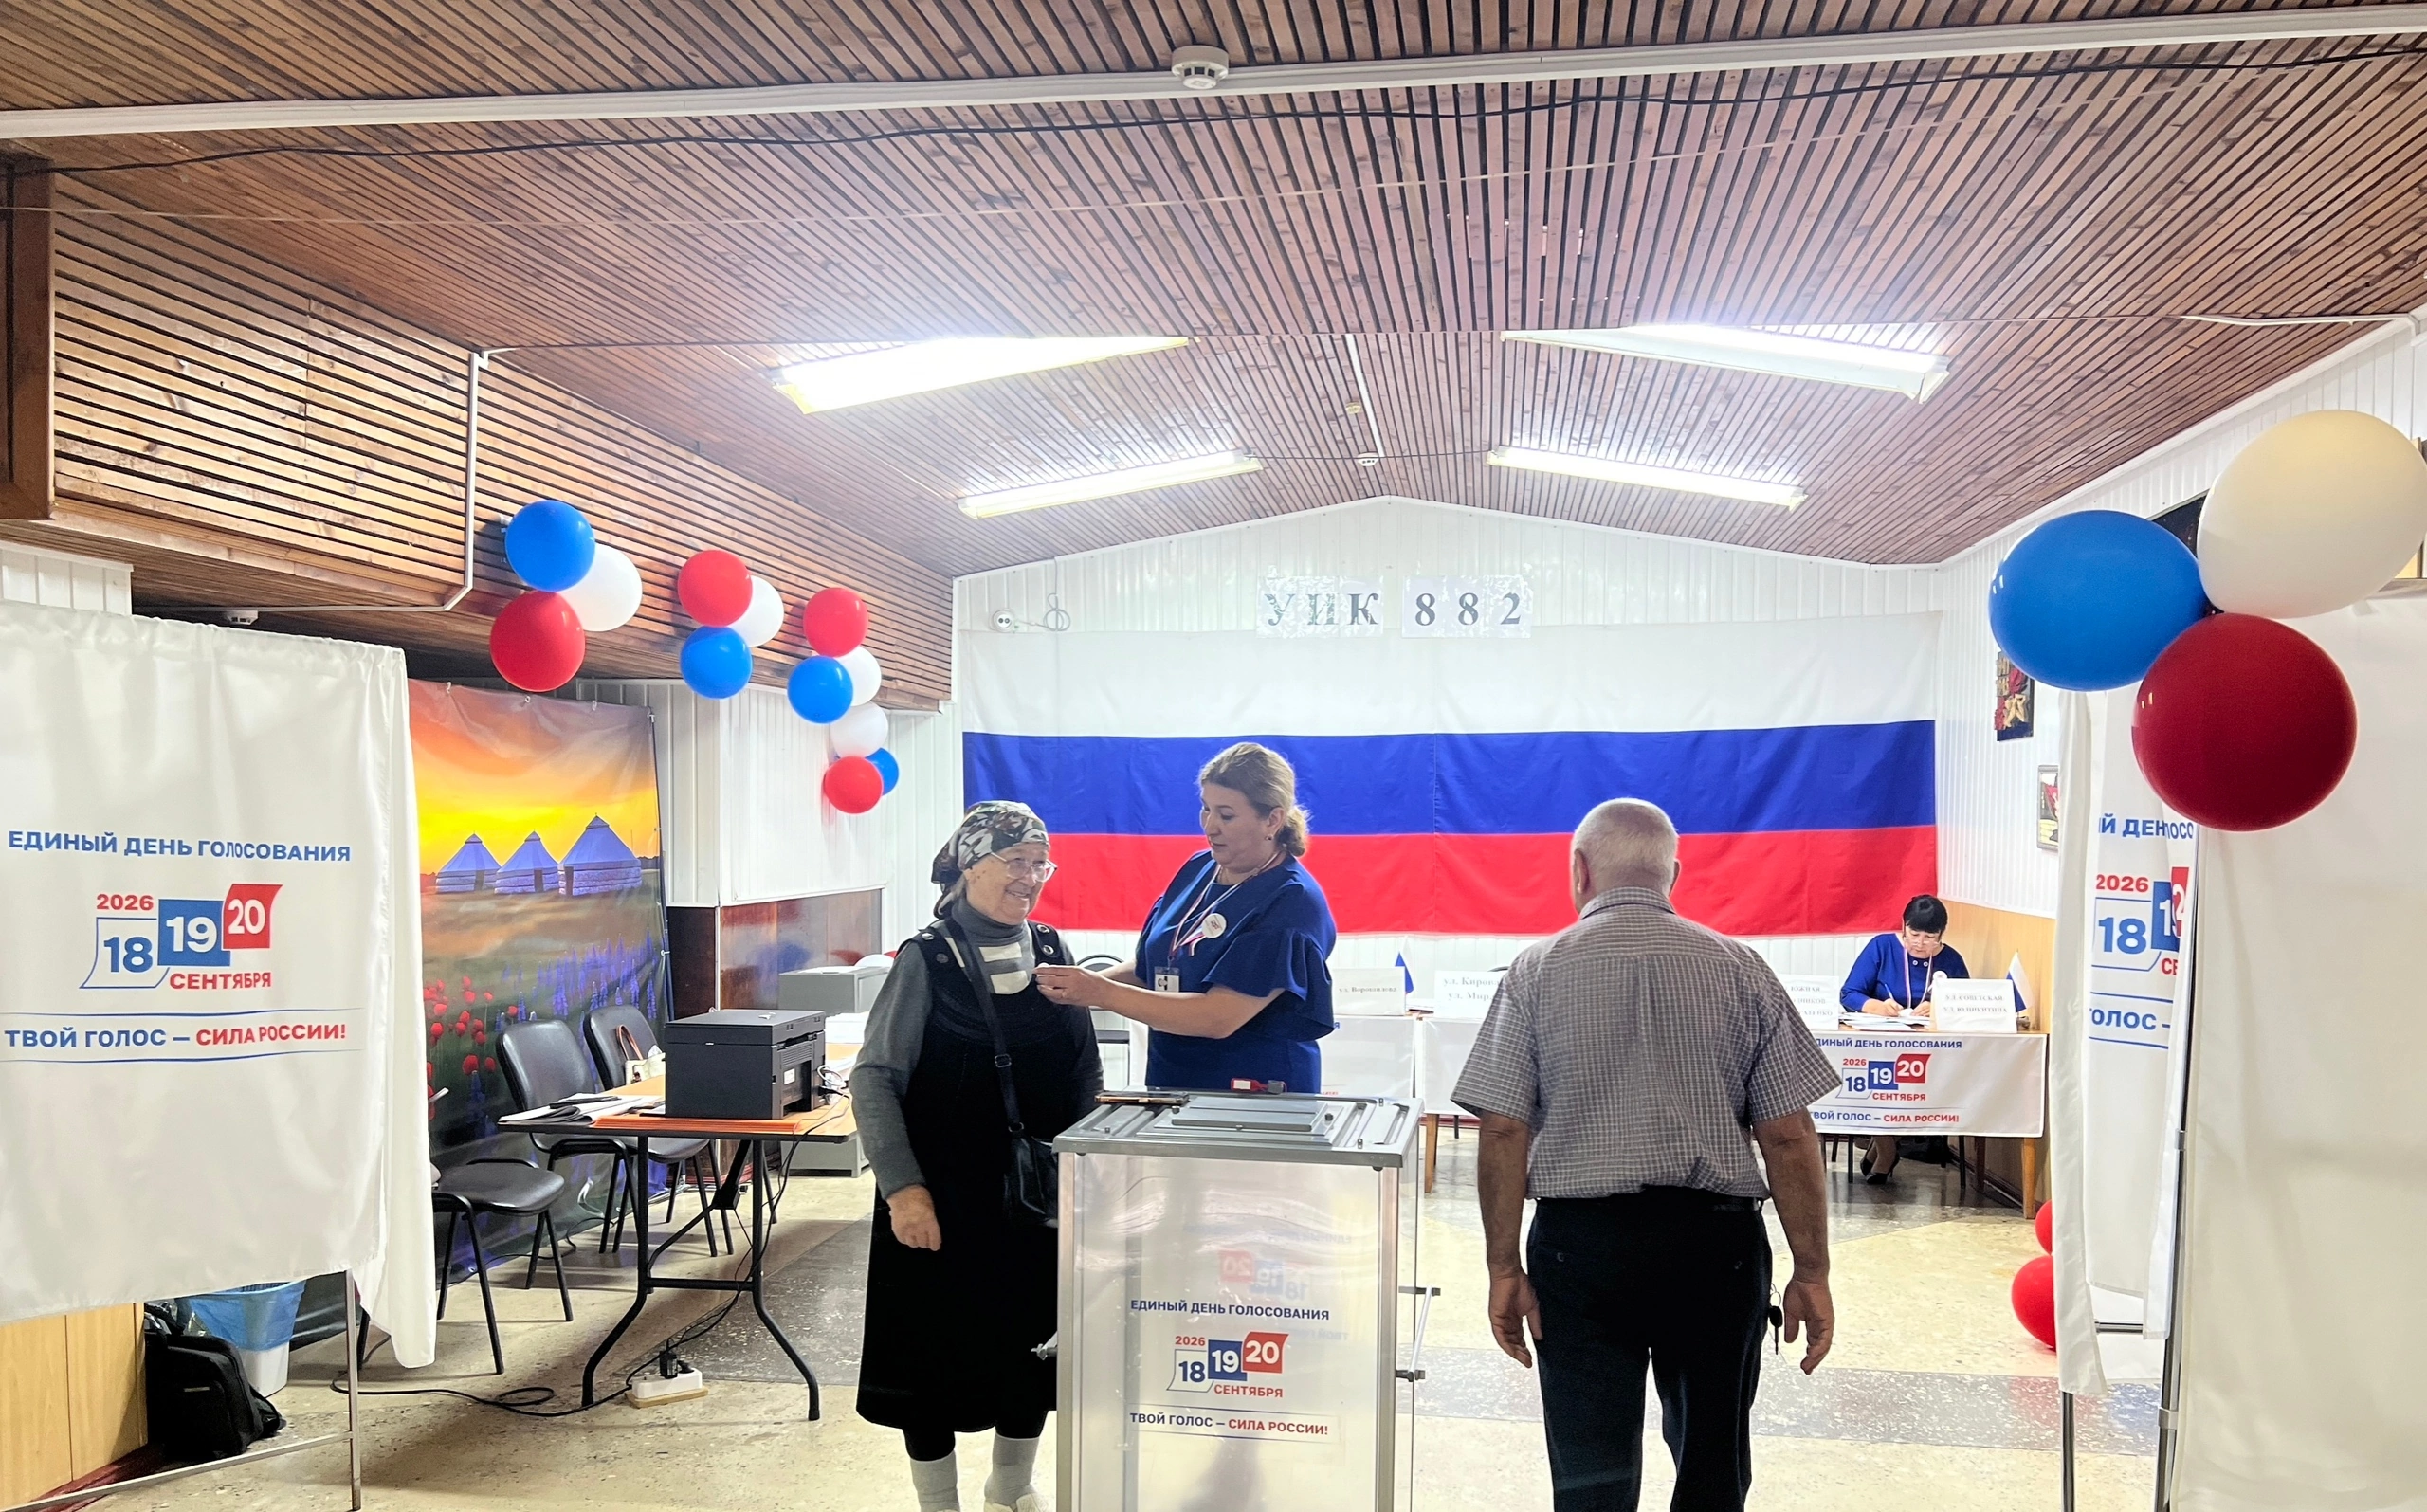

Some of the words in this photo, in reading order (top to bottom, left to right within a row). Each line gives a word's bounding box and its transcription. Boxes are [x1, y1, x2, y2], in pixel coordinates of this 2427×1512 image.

[1264, 592, 1378, 627] УИК
[1414, 592, 1522, 627] 882
[2122, 818, 2165, 838] ДЕН
[8, 830, 118, 853] ЕДИНЫЙ
[123, 837, 192, 856] ДЕНЬ
[197, 840, 351, 862] ГОЛОСОВАНИЯ
[2095, 874, 2149, 893] 2026
[96, 894, 154, 911] 2026
[103, 936, 153, 973] 18
[166, 916, 217, 953] 19
[228, 899, 265, 935] 20
[2098, 916, 2146, 955] 18
[169, 971, 271, 990] СЕНТЯБРЯ
[2089, 1008, 2157, 1030] ОЛОС
[4, 1026, 77, 1047] ТВОЙ
[85, 1029, 166, 1047] ГОЛОС
[196, 1028, 255, 1046] СИЛА
[259, 1024, 347, 1043] РОССИИ!
[1815, 1038, 1852, 1047] ДИНЫЙ
[1854, 1039, 1882, 1047] ДЕНЬ
[1884, 1040, 1962, 1048] ГОЛОСОВАНИЯ
[1843, 1058, 1867, 1066] 2026
[1845, 1076, 1866, 1092] 18
[1870, 1067, 1892, 1084] 19
[1897, 1060, 1925, 1077] 20
[1872, 1092, 1926, 1102] СЕНТЯБРЯ
[1837, 1111, 1871, 1121] ГОЛОС
[1883, 1114, 1911, 1122] СИЛА
[1914, 1114, 1960, 1123] РОССИИ!
[1130, 1300, 1187, 1313] ЕДИНЫЙ
[1191, 1303, 1226, 1314] ДЕНЬ
[1229, 1304, 1330, 1321] ГОЛОСОВАНИЯ
[1175, 1335, 1206, 1346] 2026
[1178, 1361, 1206, 1383] 18
[1212, 1350, 1239, 1373] 19
[1245, 1340, 1280, 1364] 20
[1214, 1384, 1284, 1398] СЕНТЯБРЯ
[1130, 1412, 1165, 1425] ТВОЙ
[1169, 1414, 1214, 1427] ГОЛОС
[1228, 1419, 1266, 1431] СИЛА
[1268, 1421, 1328, 1435] РОССИИ!
